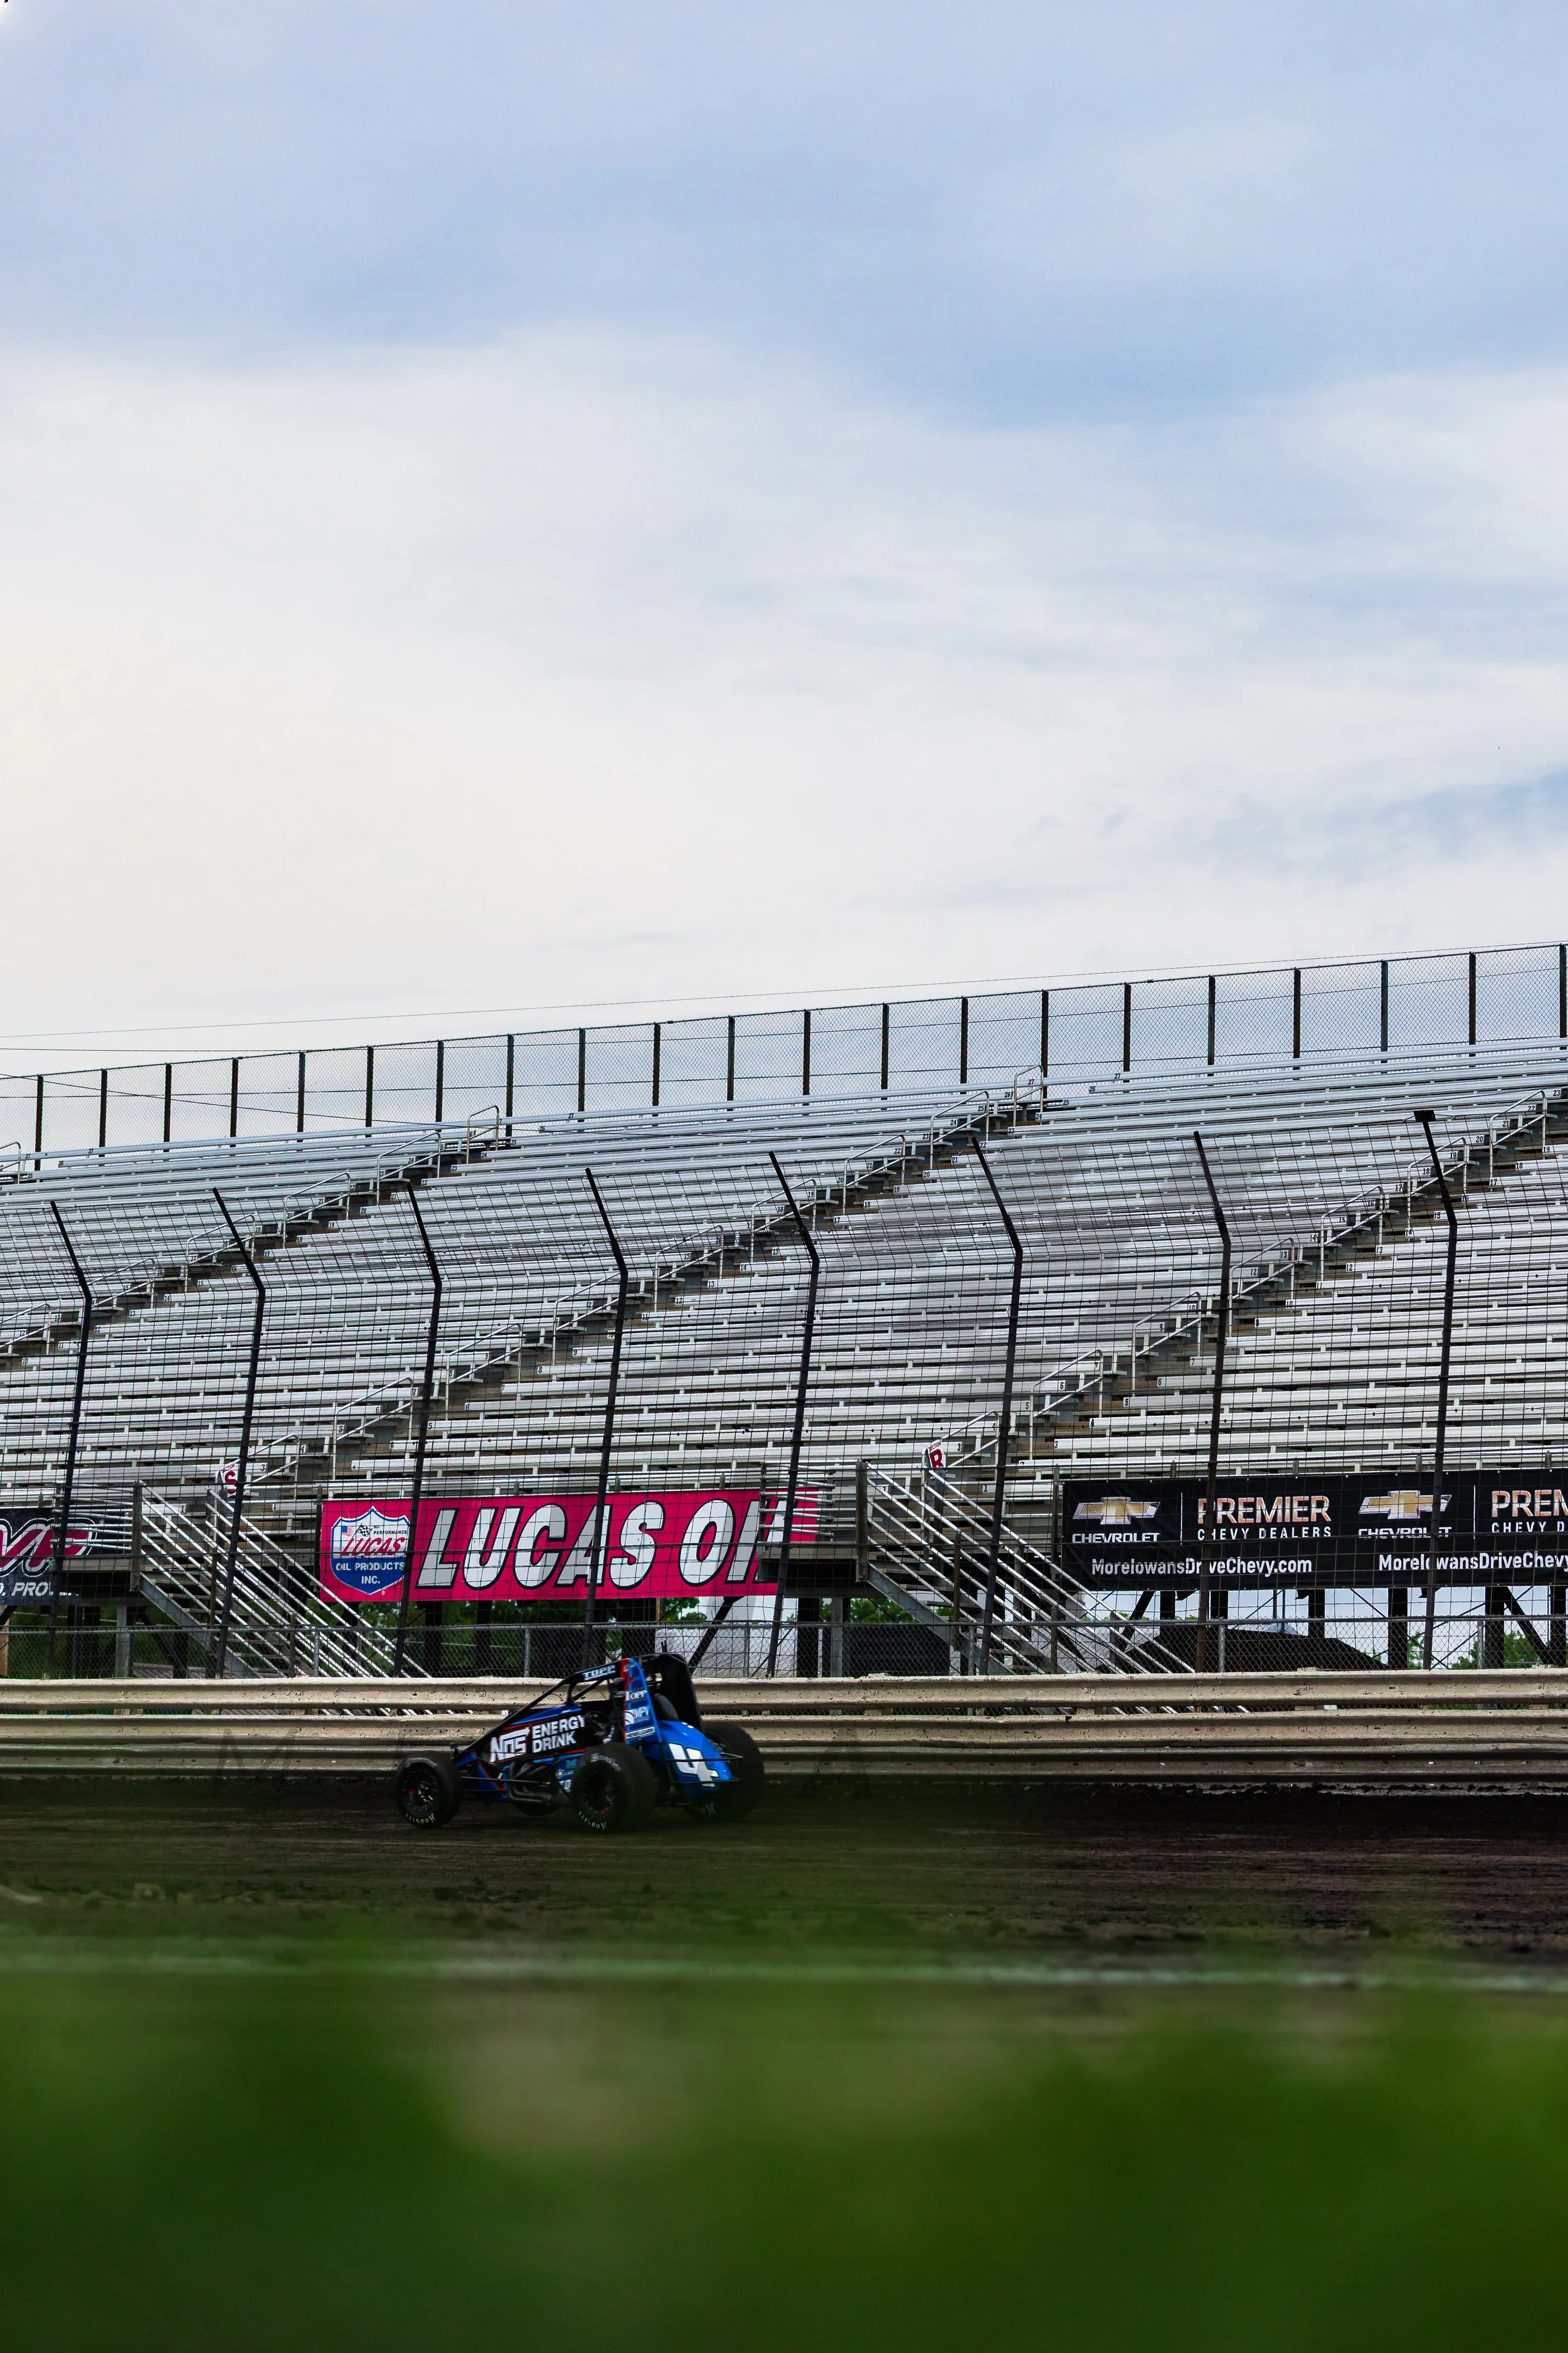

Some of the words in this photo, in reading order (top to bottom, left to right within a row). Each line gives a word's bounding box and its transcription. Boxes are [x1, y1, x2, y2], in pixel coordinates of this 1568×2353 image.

[1160, 1323, 1163, 1331] 9
[1158, 1378, 1162, 1386] 6
[1025, 1401, 1029, 1410] 5
[957, 1443, 961, 1451] 3
[1054, 1440, 1058, 1448] 3
[930, 1448, 944, 1473] R
[225, 1470, 238, 1494] S
[1198, 1495, 1332, 1524] PREMIER
[1198, 1528, 1249, 1541] CHEVY
[1259, 1526, 1331, 1538] DEALERS
[1491, 1521, 1546, 1533] CHEVY
[415, 1500, 666, 1590] LUCAS
[1072, 1532, 1160, 1543] CHEVROLET
[341, 1537, 406, 1556] LUCAS
[336, 1563, 351, 1571] OIL
[355, 1561, 405, 1571] PRODUCTS
[1092, 1556, 1312, 1577] MoreIowansDrveChevy.com
[361, 1575, 380, 1584] INC.
[532, 1715, 585, 1739] ENERGY
[490, 1727, 531, 1763] NOS
[532, 1731, 576, 1753] DRINK
[668, 1743, 719, 1787] 4
